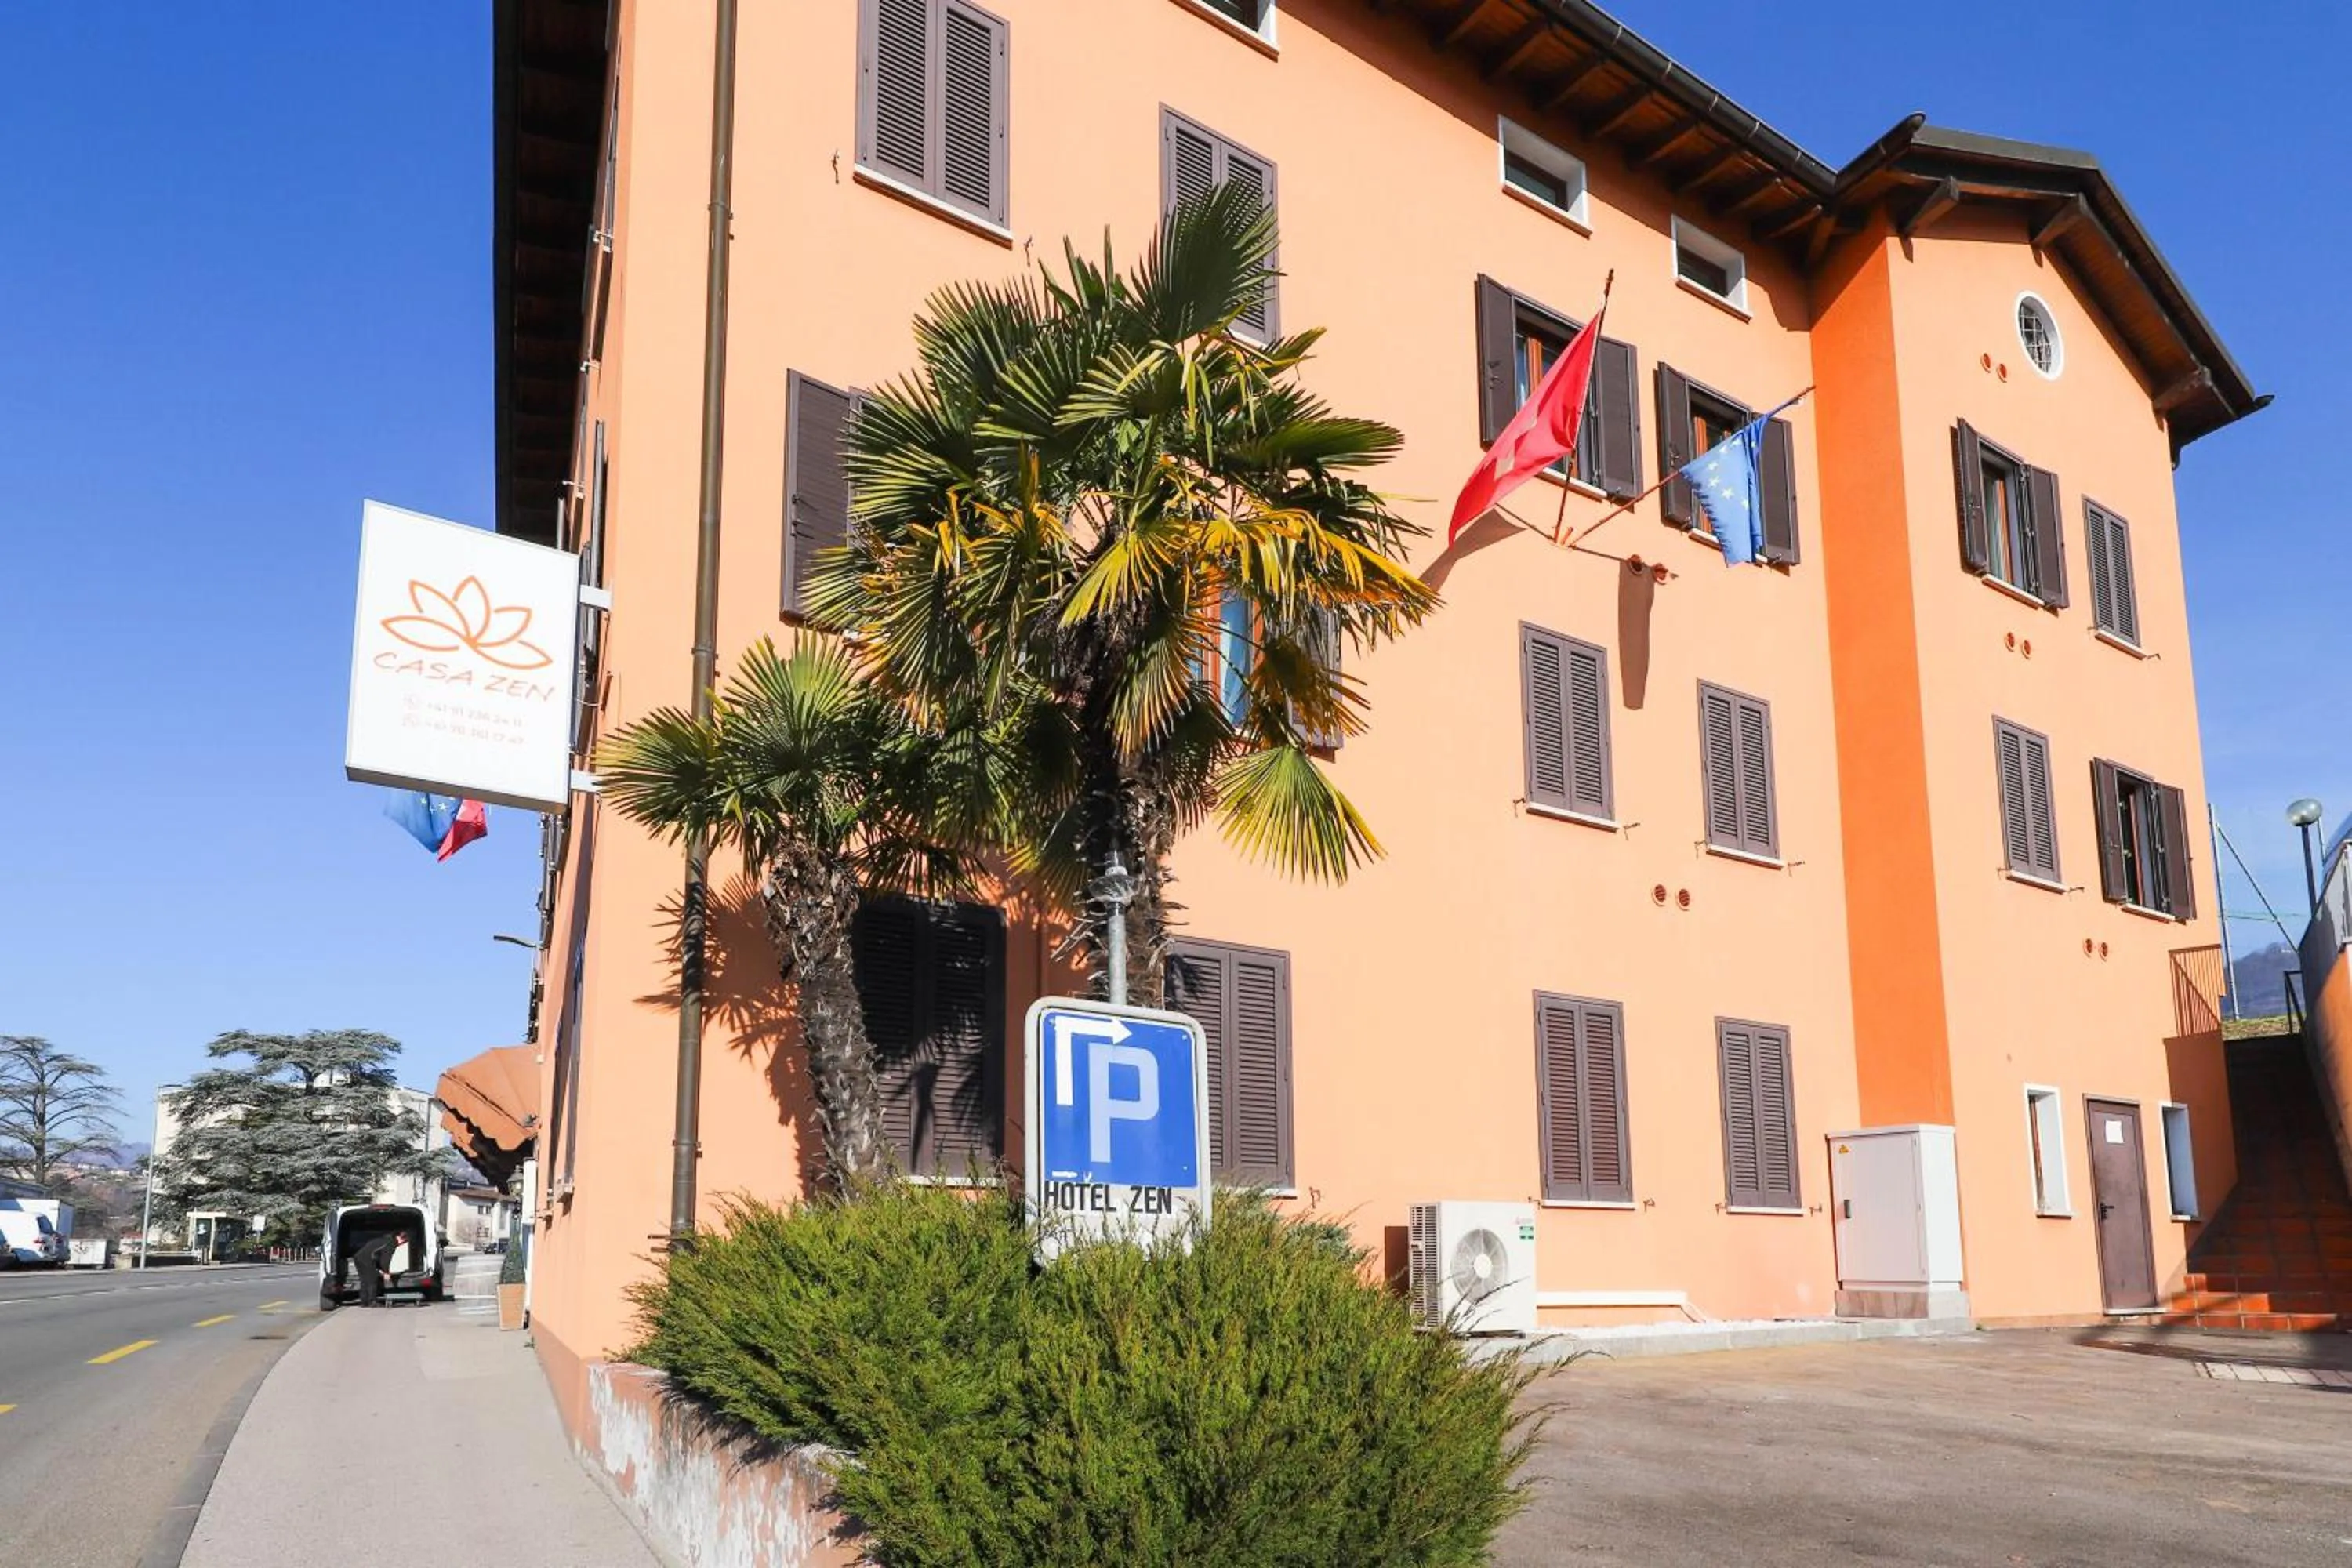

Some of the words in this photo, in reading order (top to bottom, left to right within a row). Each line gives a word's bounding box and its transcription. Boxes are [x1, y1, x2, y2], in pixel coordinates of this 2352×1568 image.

[373, 652, 473, 686] CASA
[484, 674, 556, 702] ZEN
[1088, 1042, 1160, 1163] P
[1044, 1181, 1116, 1212] HOTEL
[1130, 1184, 1172, 1214] ZEN
